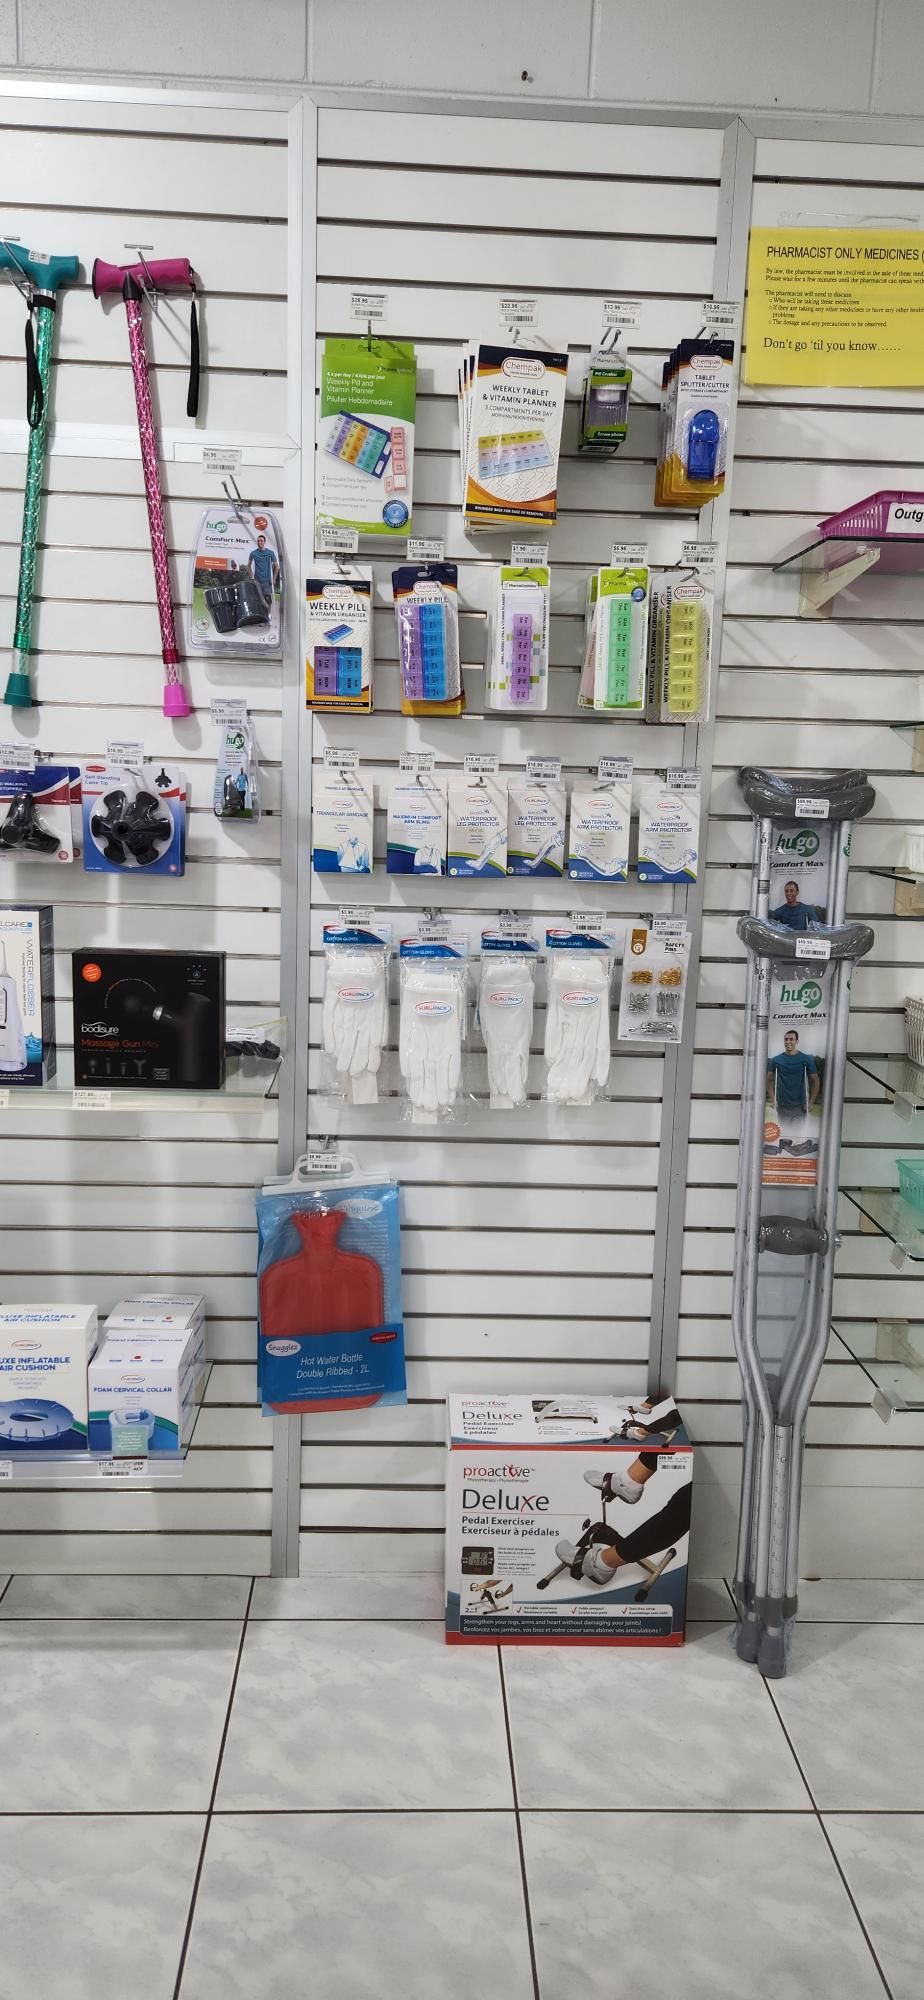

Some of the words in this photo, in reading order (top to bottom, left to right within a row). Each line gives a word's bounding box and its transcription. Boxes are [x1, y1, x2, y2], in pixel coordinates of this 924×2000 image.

[767, 246, 832, 259] PHARMACIST
[834, 247, 863, 259] ONLY
[864, 248, 919, 260] MEDICINES
[795, 341, 807, 352] go
[827, 342, 845, 353] you
[506, 361, 542, 372] Chempak
[692, 358, 720, 366] Chempak
[327, 379, 350, 387] Weekly
[327, 385, 349, 393] Vitamin
[352, 387, 374, 395] Planner
[493, 384, 521, 393] WEEKLY
[522, 387, 549, 396] TABLET
[489, 394, 521, 404] VITAMIN
[523, 398, 557, 407] PLANNER
[310, 602, 345, 610] WEEKLY
[348, 603, 367, 611] PILL
[651, 591, 659, 628] ORGANISER
[226, 734, 244, 749] hugo
[776, 834, 818, 854] hugo
[780, 985, 821, 1005] hugo
[81, 1024, 119, 1034] bodisure
[81, 1039, 119, 1049] Massage
[121, 1039, 141, 1048] Gun
[301, 1357, 315, 1366] Hot
[317, 1355, 340, 1365] Water
[341, 1353, 363, 1363] Bottle
[296, 1369, 323, 1379] Double
[326, 1366, 353, 1377] Ribbed
[360, 1365, 369, 1374] 2L
[462, 1411, 523, 1420] Deluxe
[463, 1465, 531, 1479] proactive
[462, 1489, 550, 1512] Deluxe
[462, 1516, 488, 1525] Pedal
[491, 1517, 535, 1526] Exerciser
[462, 1526, 511, 1535] Exerciseur
[514, 1527, 519, 1536] à
[521, 1528, 559, 1537] pédales
